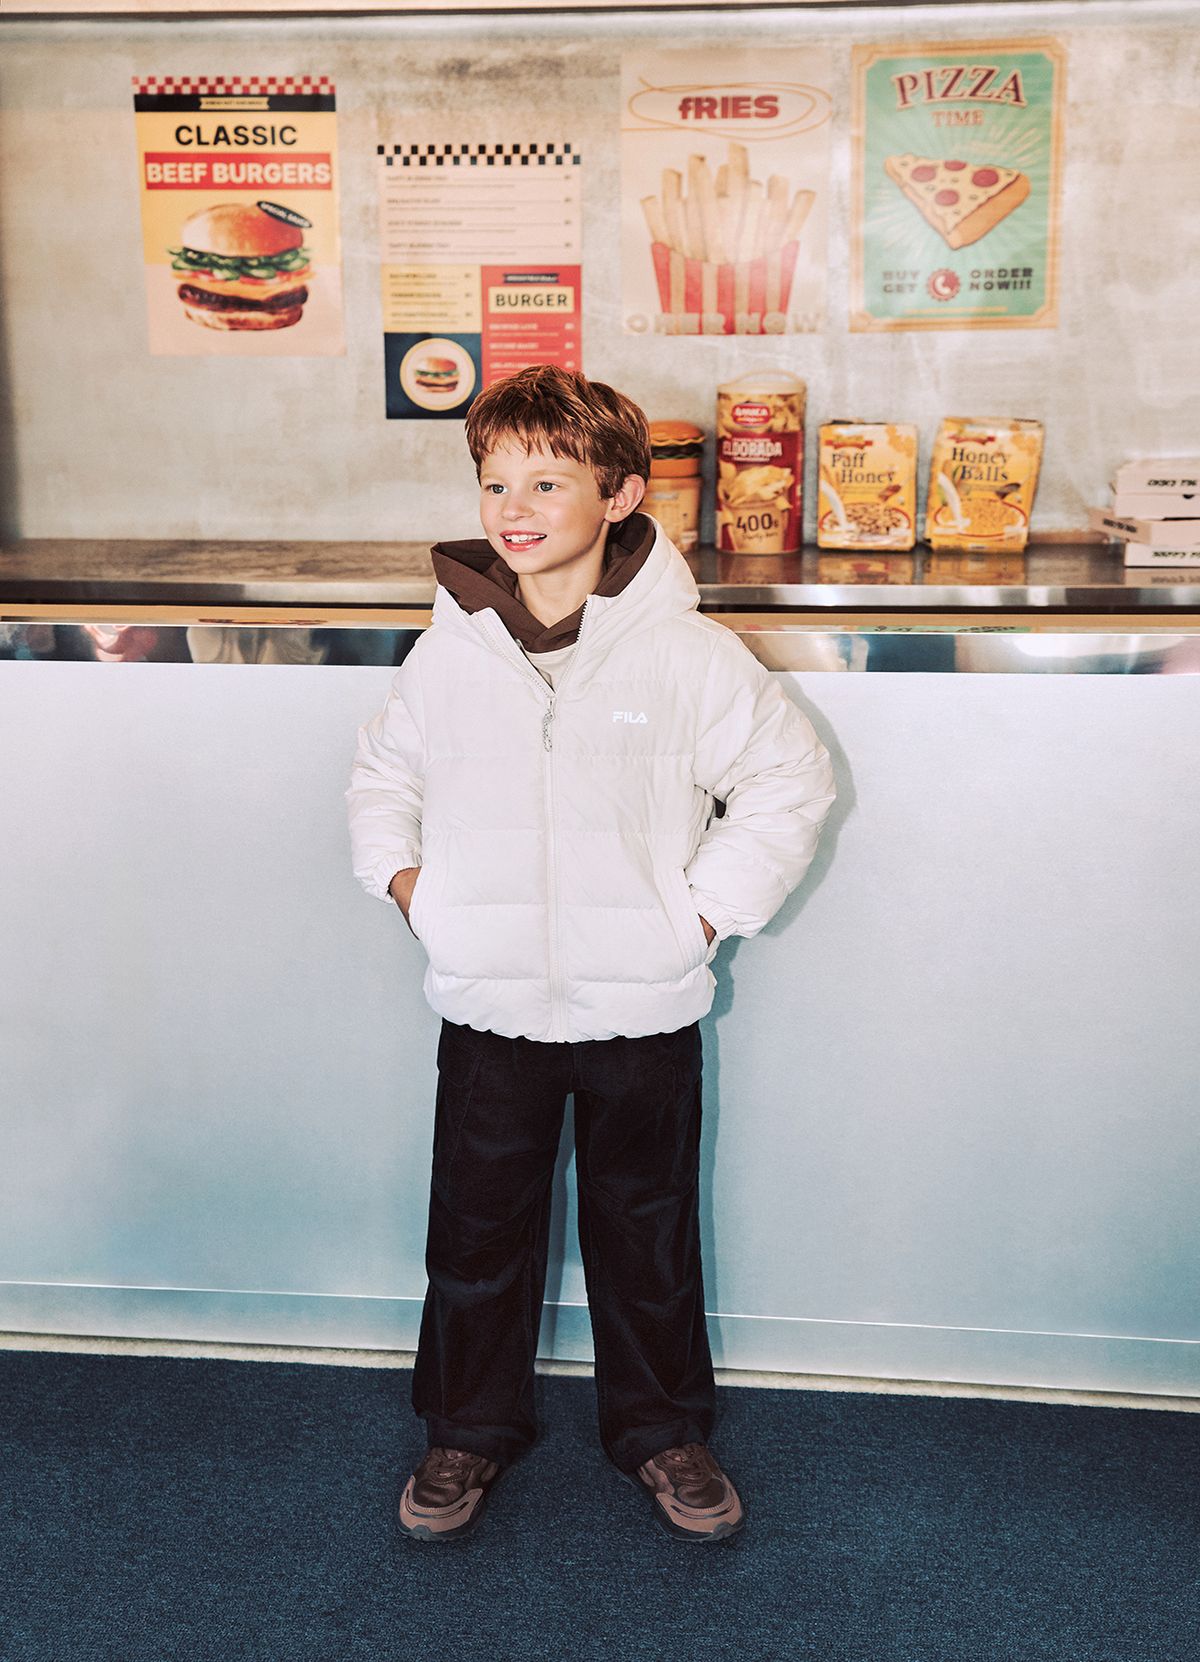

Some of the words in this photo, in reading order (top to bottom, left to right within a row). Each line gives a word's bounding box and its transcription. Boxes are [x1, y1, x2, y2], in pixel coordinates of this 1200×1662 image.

[895, 66, 1024, 107] PIZZA
[932, 110, 985, 127] TIME
[175, 125, 298, 146] CLASSIC
[146, 162, 207, 183] BEEF
[212, 162, 331, 184] BURGERS
[970, 268, 1033, 279] ORDER
[970, 281, 1031, 291] NOW!!!
[495, 293, 569, 307] BURGER
[952, 447, 1008, 465] Honey
[841, 469, 897, 483] Honey
[612, 711, 649, 724] FILA
